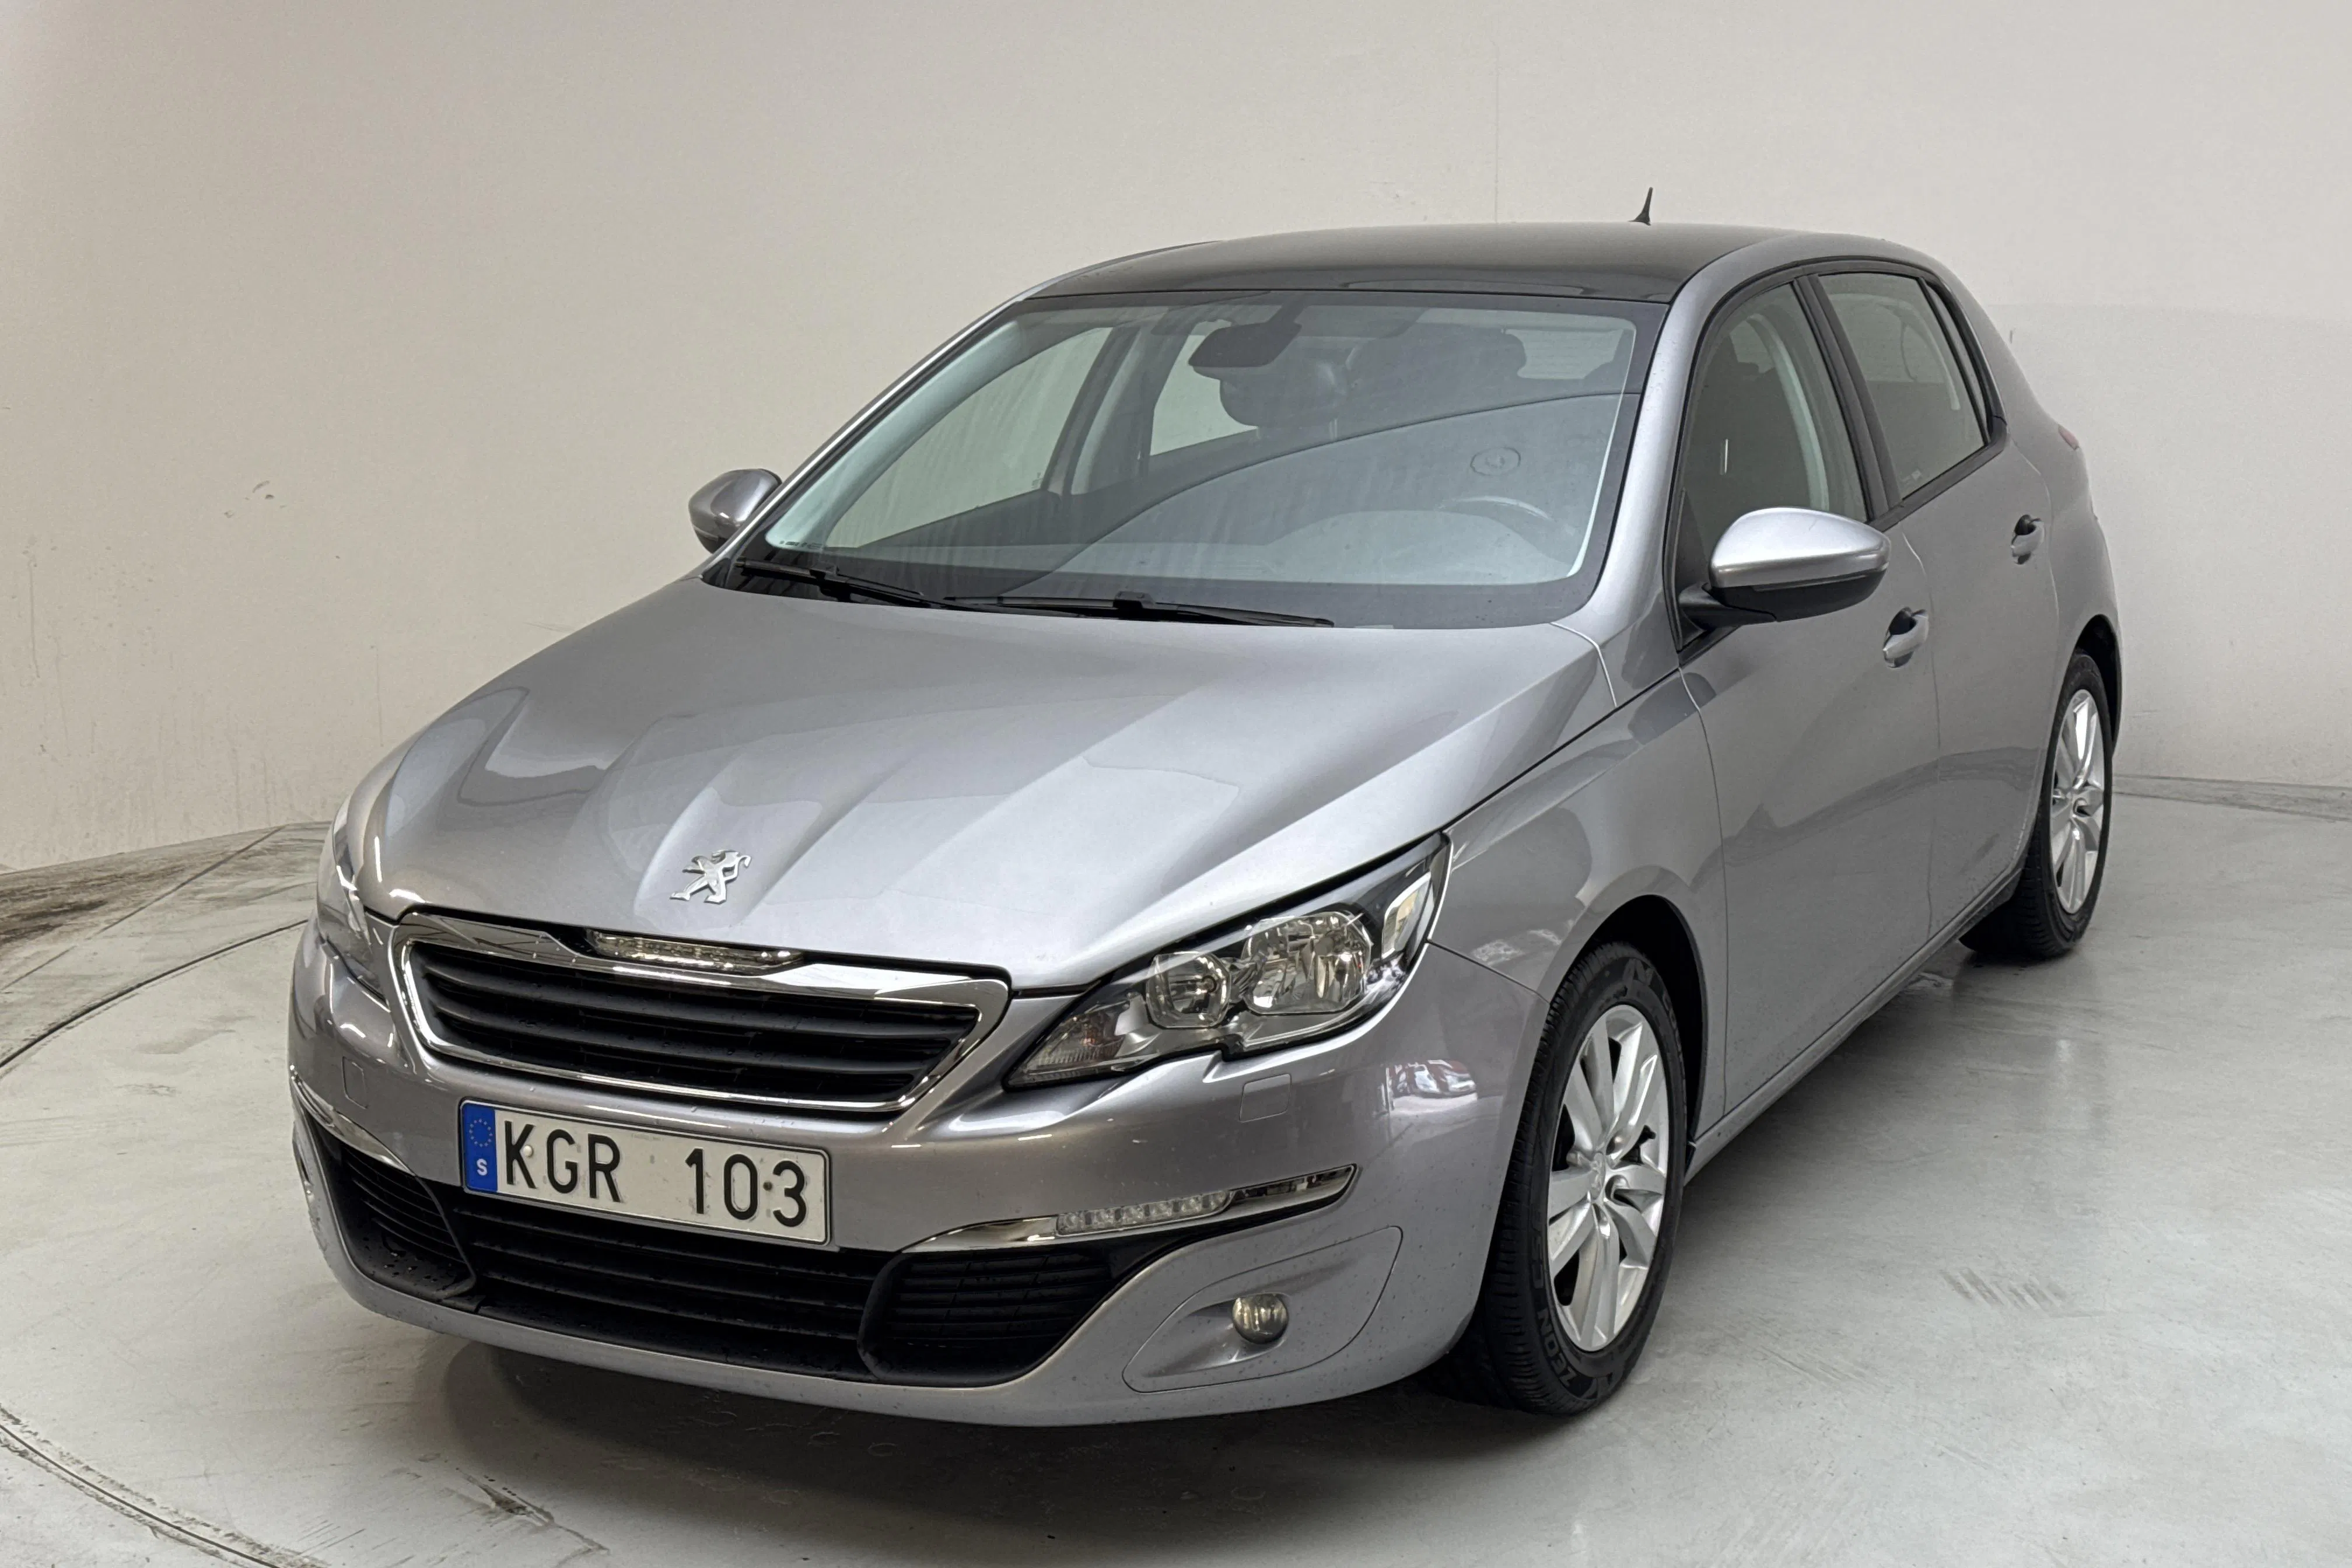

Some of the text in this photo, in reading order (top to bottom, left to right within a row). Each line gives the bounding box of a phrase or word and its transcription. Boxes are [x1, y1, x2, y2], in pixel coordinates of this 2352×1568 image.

[475, 1158, 488, 1177] S
[504, 1120, 807, 1228] KGR 103
[1536, 1307, 1577, 1387] ZEON
